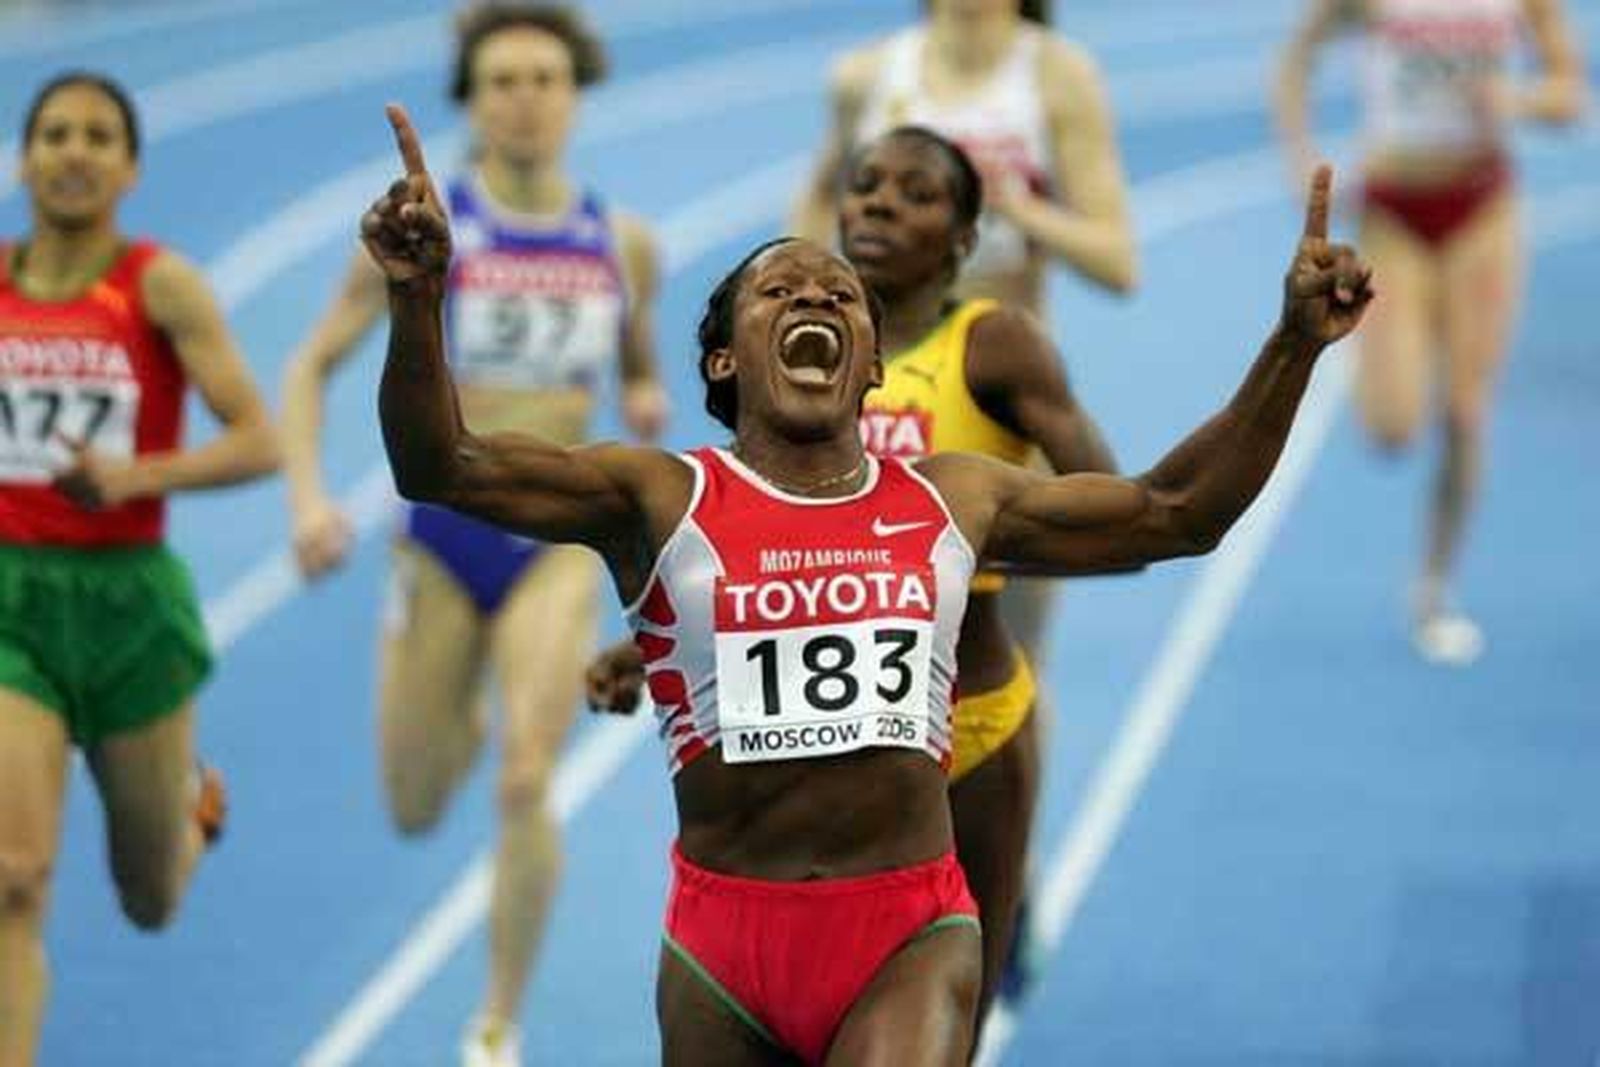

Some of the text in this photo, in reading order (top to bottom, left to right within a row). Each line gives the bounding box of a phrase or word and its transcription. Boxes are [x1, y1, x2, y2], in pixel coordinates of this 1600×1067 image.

[0, 337, 132, 378] OYOTA
[725, 572, 931, 623] TOYOTA
[746, 629, 918, 716] 183
[739, 722, 862, 752] MOSCOW
